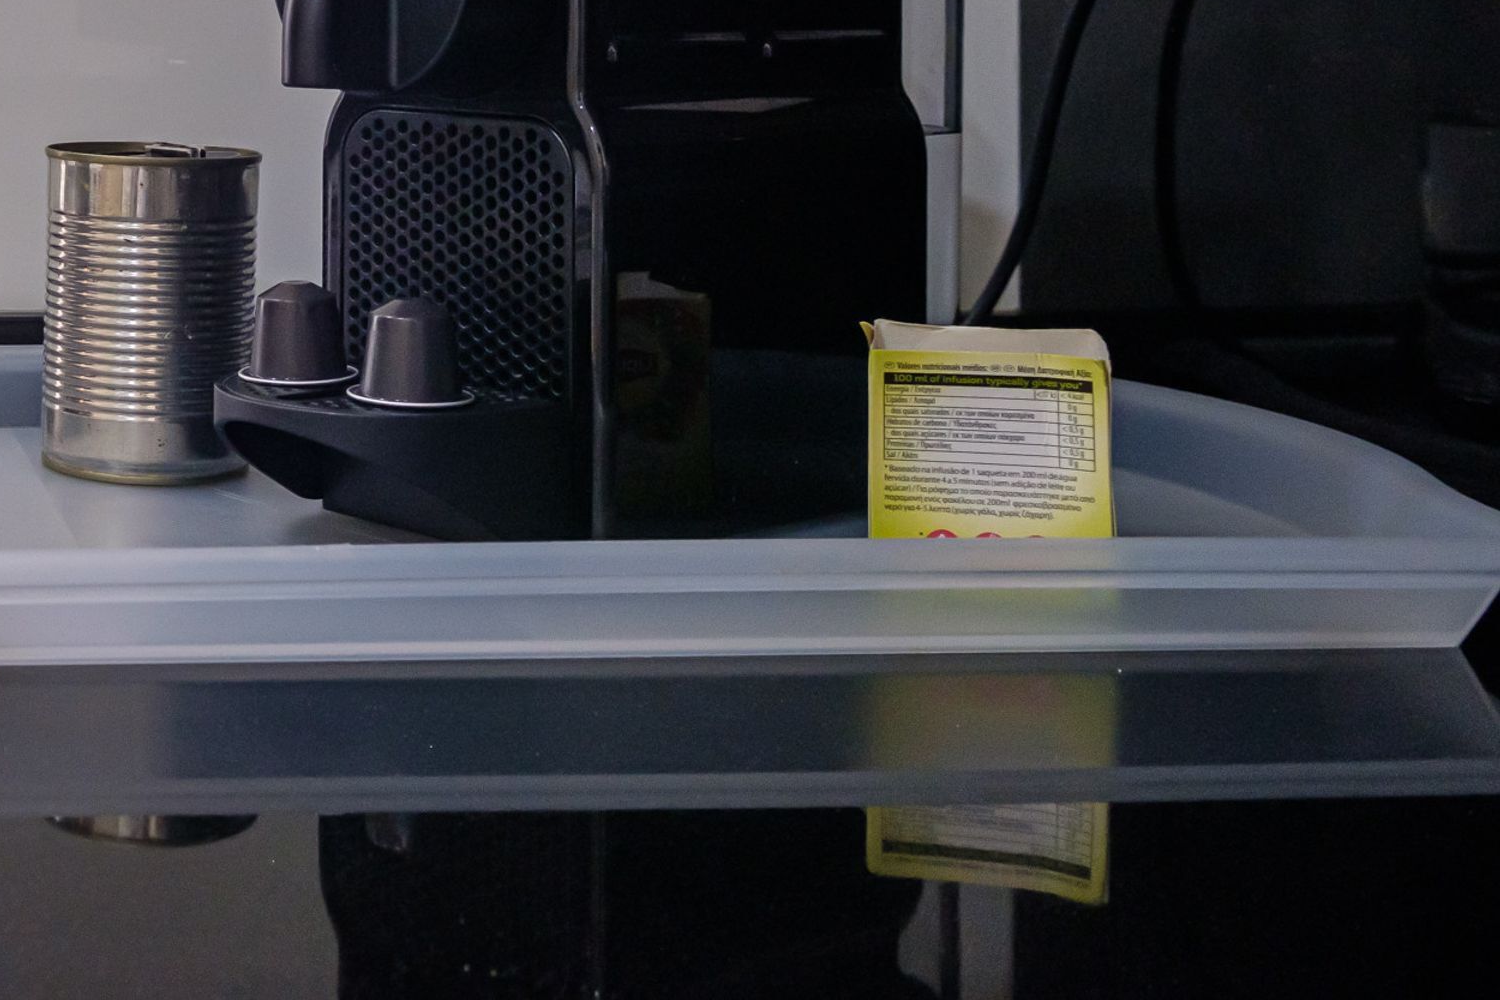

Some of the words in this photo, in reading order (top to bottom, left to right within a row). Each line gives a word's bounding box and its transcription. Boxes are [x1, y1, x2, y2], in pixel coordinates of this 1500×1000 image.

[893, 374, 913, 382] 100
[914, 374, 928, 382] ml
[929, 375, 940, 383] of
[942, 375, 984, 384] infusion
[986, 377, 1030, 388] typically
[1031, 380, 1058, 389] gives
